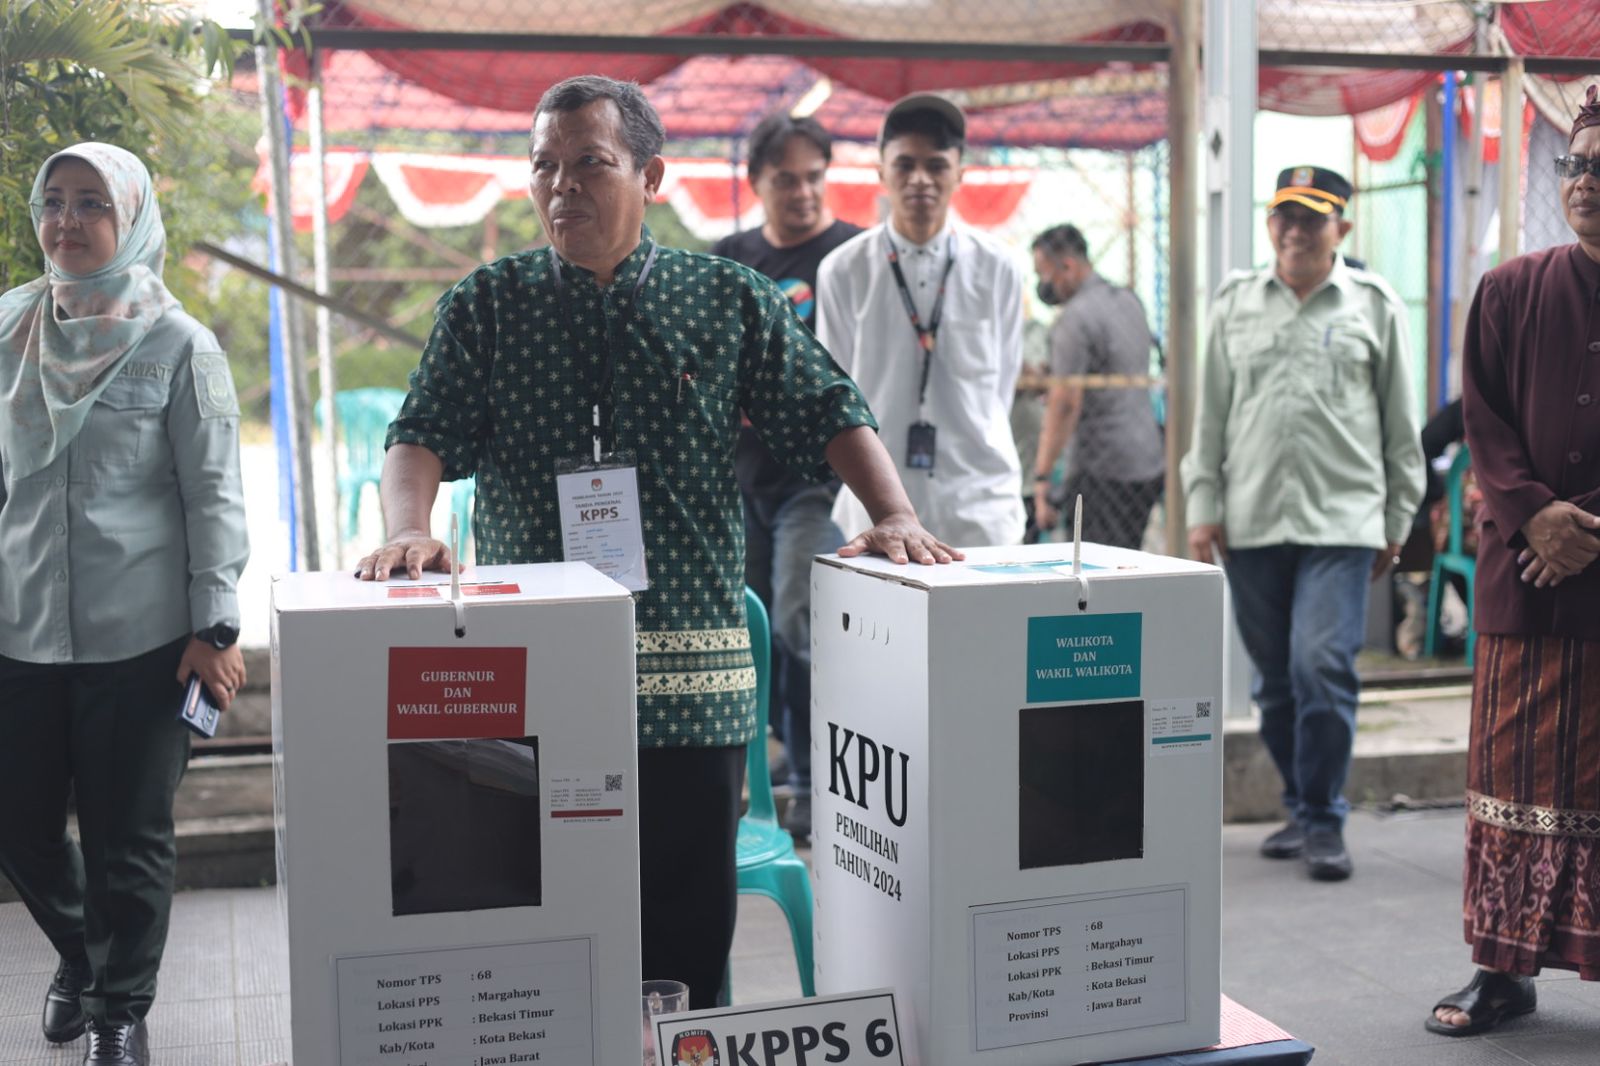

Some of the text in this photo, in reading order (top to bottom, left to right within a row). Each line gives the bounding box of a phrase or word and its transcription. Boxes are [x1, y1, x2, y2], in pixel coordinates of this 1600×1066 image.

[120, 361, 174, 383] AMAT
[580, 506, 618, 522] KPPS
[1056, 635, 1114, 648] WALIKOTA
[1073, 651, 1096, 662] DAN
[421, 671, 495, 682] GUBERNUR
[1036, 664, 1132, 680] WAKIL WALIKOTA
[443, 687, 472, 698] DAN
[397, 703, 518, 714] WAKIL GUBERNUR
[827, 721, 910, 827] KPU
[835, 811, 899, 864] PEMILIHAN
[833, 844, 902, 902] TAHUN 2024
[1007, 930, 1040, 941] Nomor
[1042, 926, 1061, 937] TPS
[1090, 921, 1103, 931] 68
[1007, 948, 1039, 961] Lokasi
[1041, 946, 1060, 957] PPS
[1090, 937, 1143, 951] Margahayu
[377, 978, 417, 989] Nomor
[419, 974, 442, 985] TPS
[477, 970, 492, 980] 68
[1008, 969, 1039, 982] Lokasi
[1042, 966, 1062, 977] PPK
[1091, 959, 1122, 971] Bekasi
[1125, 955, 1154, 966] Timur
[1008, 988, 1055, 1002] Kab/Kota
[1091, 980, 1113, 990] Kota
[1115, 974, 1147, 987] Bekasi
[378, 998, 416, 1011] Lokasi
[418, 996, 441, 1007] PPS
[478, 989, 541, 1002] Margahayu
[1008, 1008, 1049, 1022] Provinsi
[1091, 1001, 1113, 1012] Jawa
[1116, 996, 1142, 1007] Barat
[378, 1020, 416, 1032] Lokasi
[419, 1017, 443, 1029] PPK
[478, 1010, 516, 1023] Bekasi
[519, 1009, 555, 1019] Timur
[379, 1041, 435, 1054] Kab/Kota
[479, 1034, 505, 1044] Kota
[508, 1029, 546, 1042] Bekasi
[679, 1030, 707, 1039] KOMISI
[726, 1018, 894, 1066] KPPS 6
[480, 1056, 506, 1066] Jawa
[509, 1052, 540, 1063] Barat
